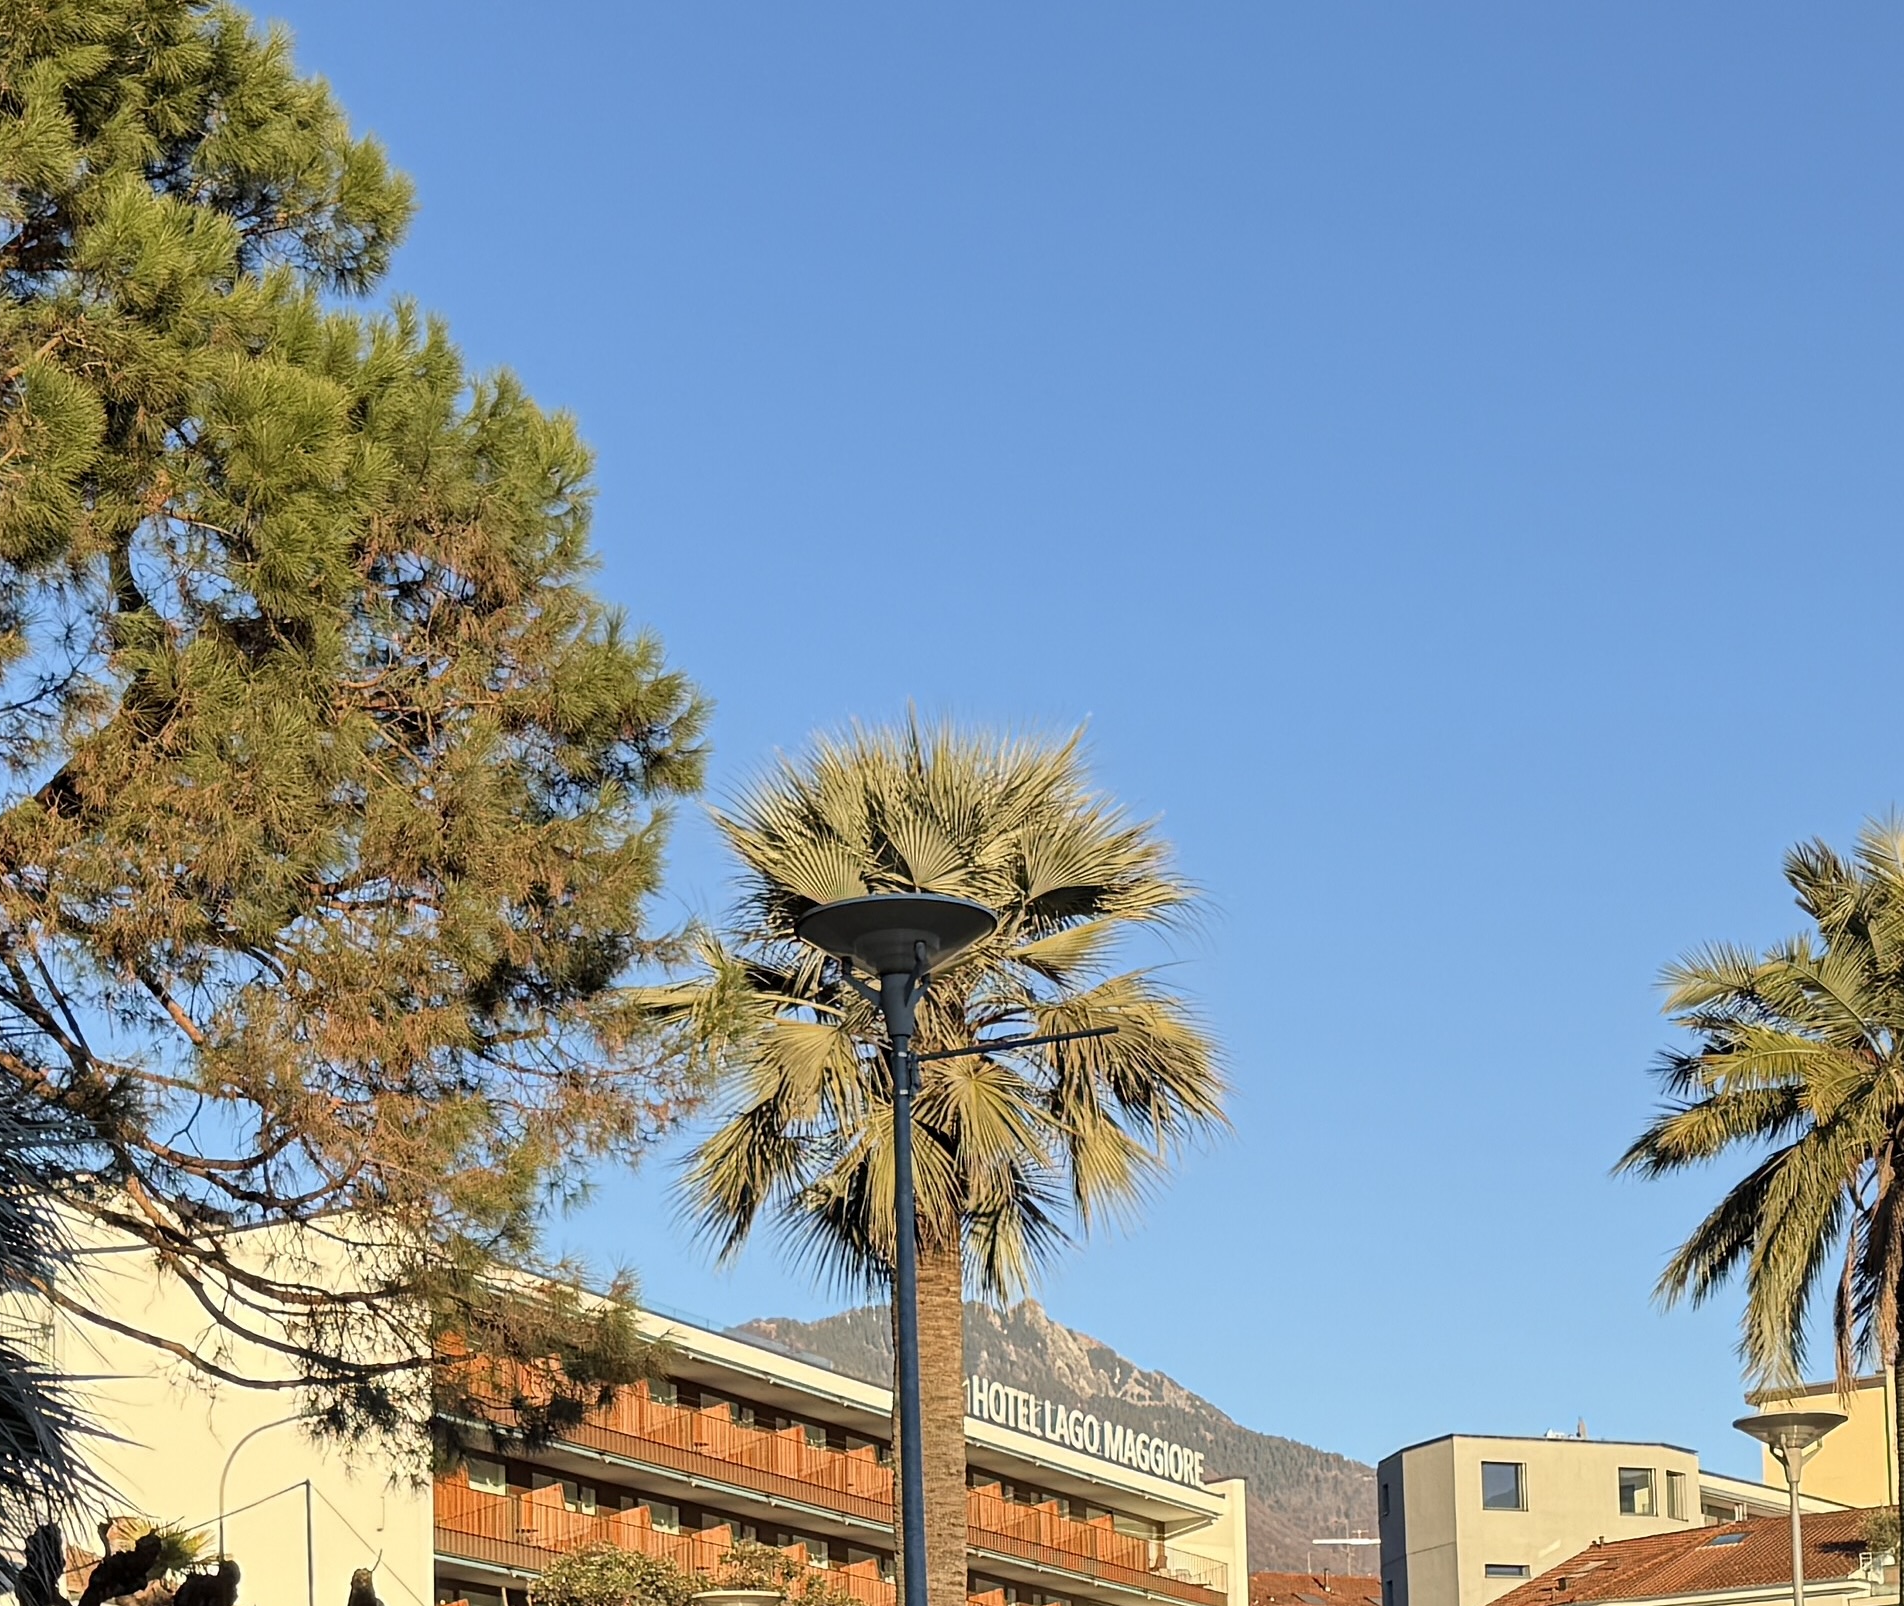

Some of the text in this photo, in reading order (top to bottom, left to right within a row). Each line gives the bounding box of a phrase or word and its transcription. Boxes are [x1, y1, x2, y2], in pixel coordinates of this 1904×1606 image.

[972, 1374, 1206, 1489] HOTEL LAGO MAGGIORE
